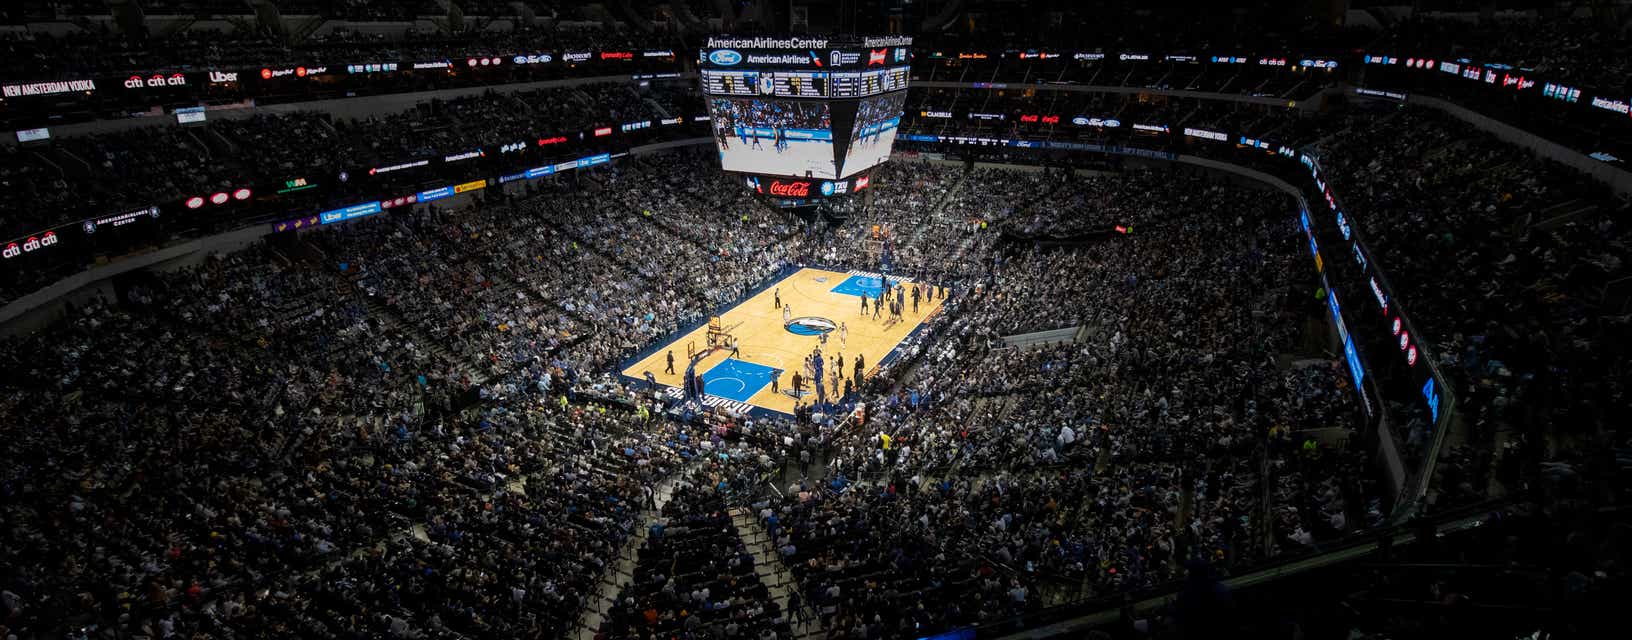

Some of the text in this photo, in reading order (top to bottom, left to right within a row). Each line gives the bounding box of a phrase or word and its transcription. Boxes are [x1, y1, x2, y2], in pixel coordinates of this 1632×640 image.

[124, 73, 186, 88] citi citi citi
[209, 72, 237, 82] Uber
[2, 80, 96, 97] NEW AMSTERDAM VODKA
[3, 233, 58, 258] citi citi citi
